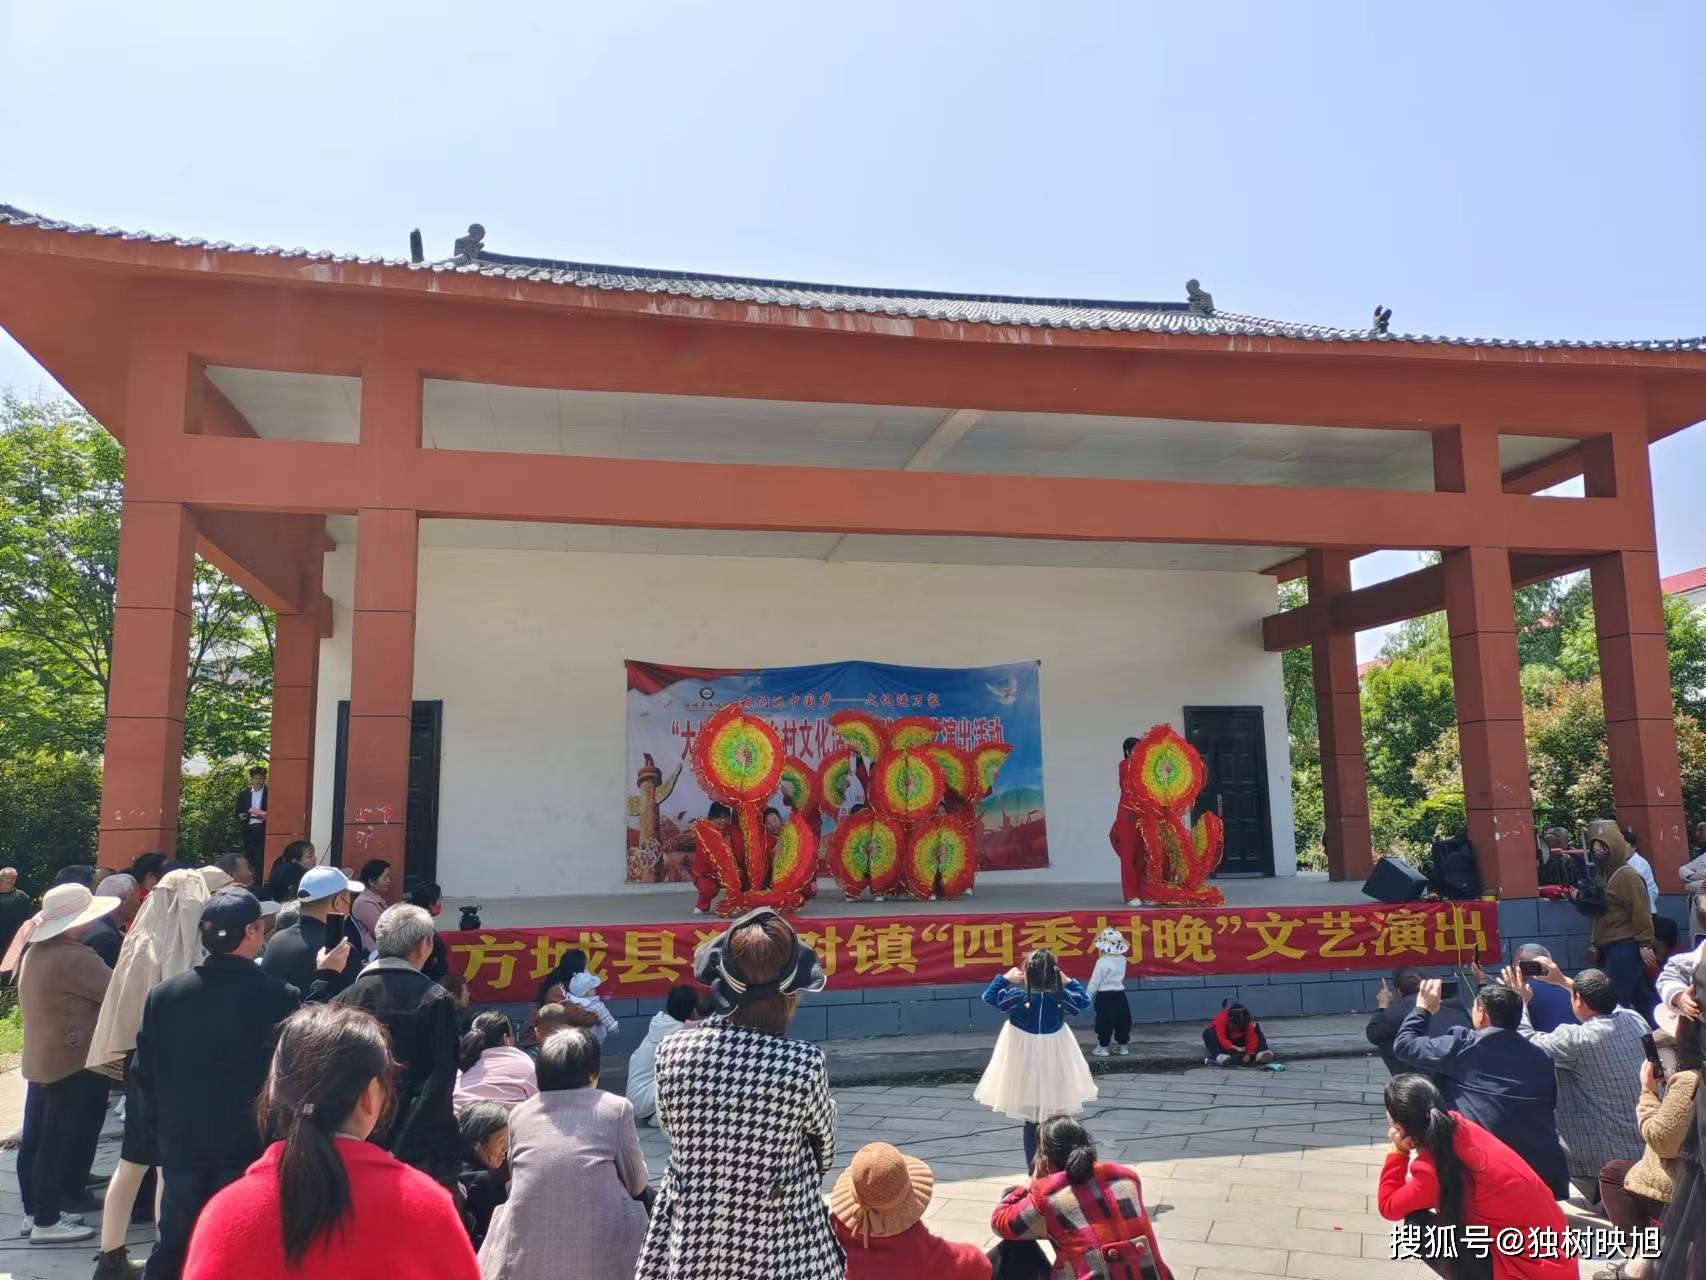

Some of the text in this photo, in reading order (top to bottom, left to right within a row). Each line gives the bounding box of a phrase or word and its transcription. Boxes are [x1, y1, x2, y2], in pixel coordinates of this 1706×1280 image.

[450, 908, 1487, 990] 方城县树镇“四季村晚”文艺演出
